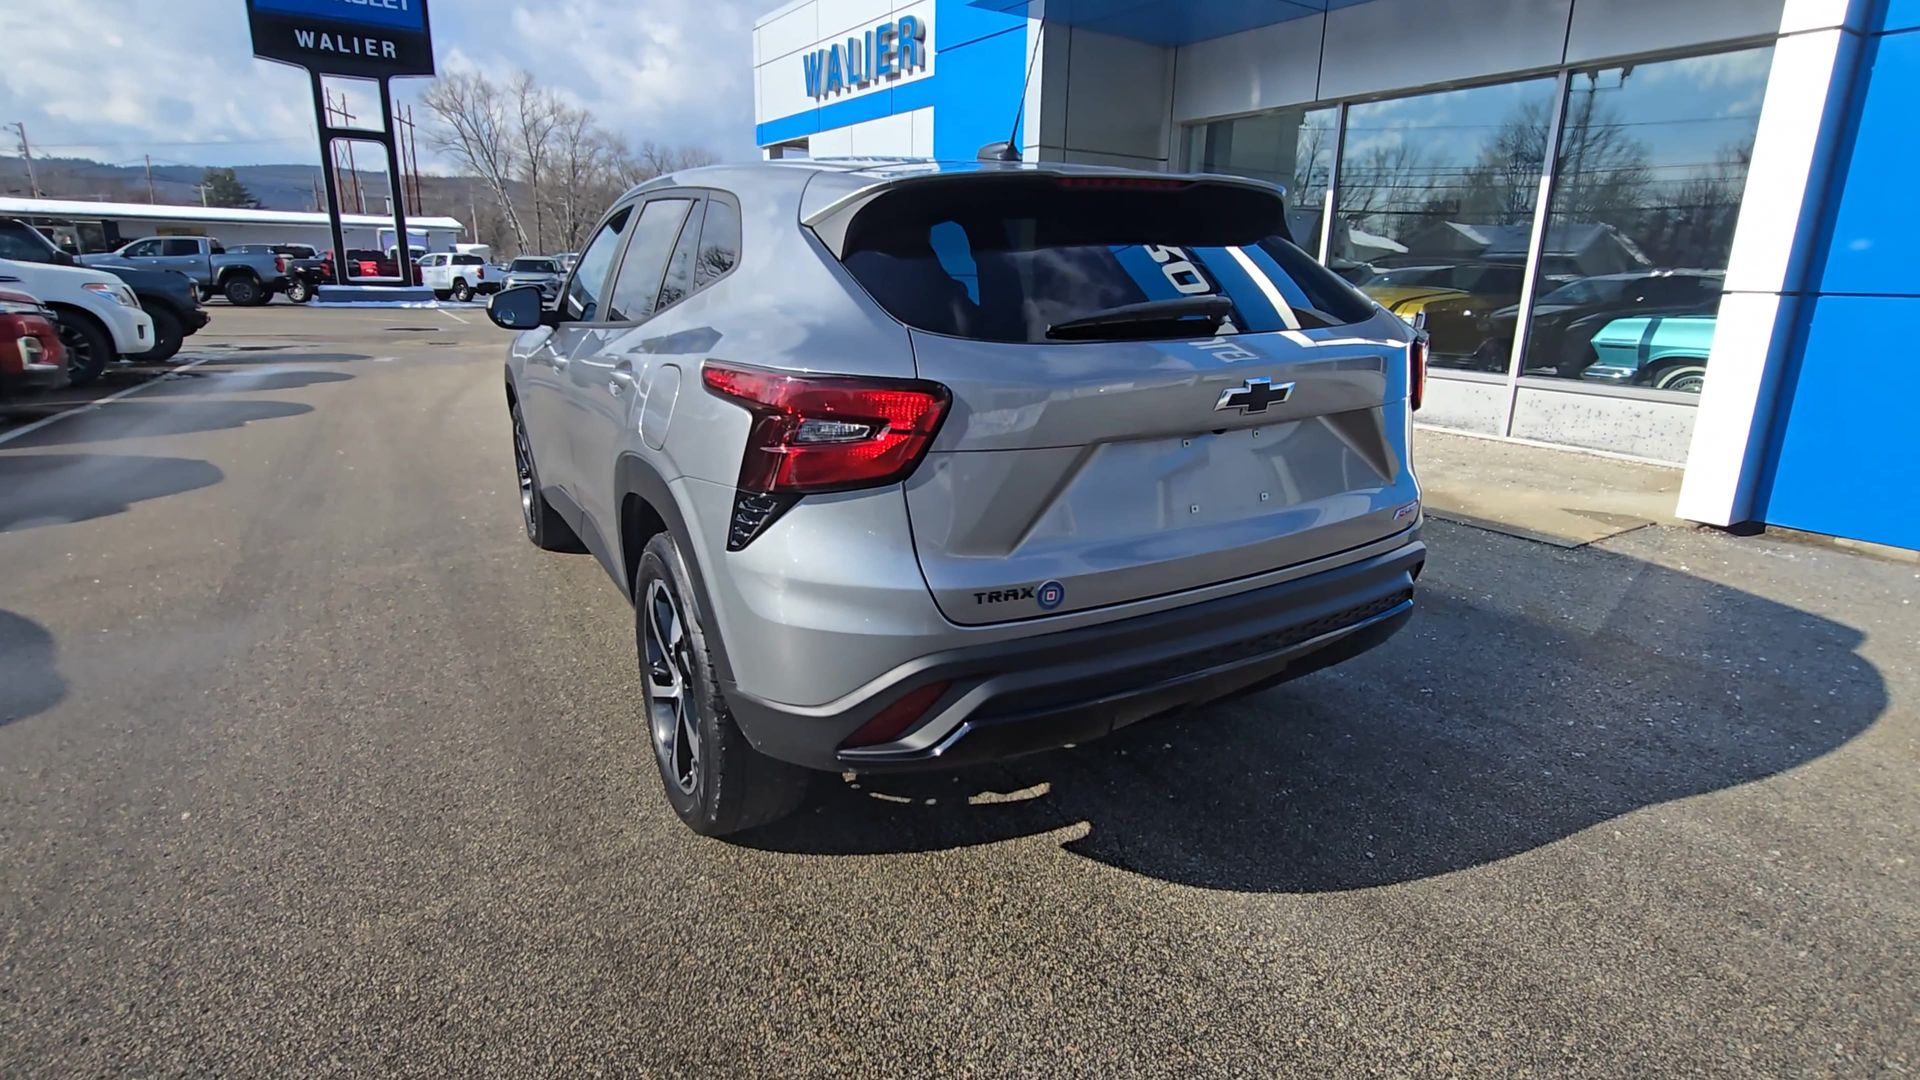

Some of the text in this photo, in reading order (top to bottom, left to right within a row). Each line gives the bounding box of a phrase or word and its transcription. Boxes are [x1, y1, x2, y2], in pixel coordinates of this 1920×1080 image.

[294, 28, 397, 59] WALIER
[803, 15, 925, 101] WALIER
[973, 586, 1034, 605] TRAX
